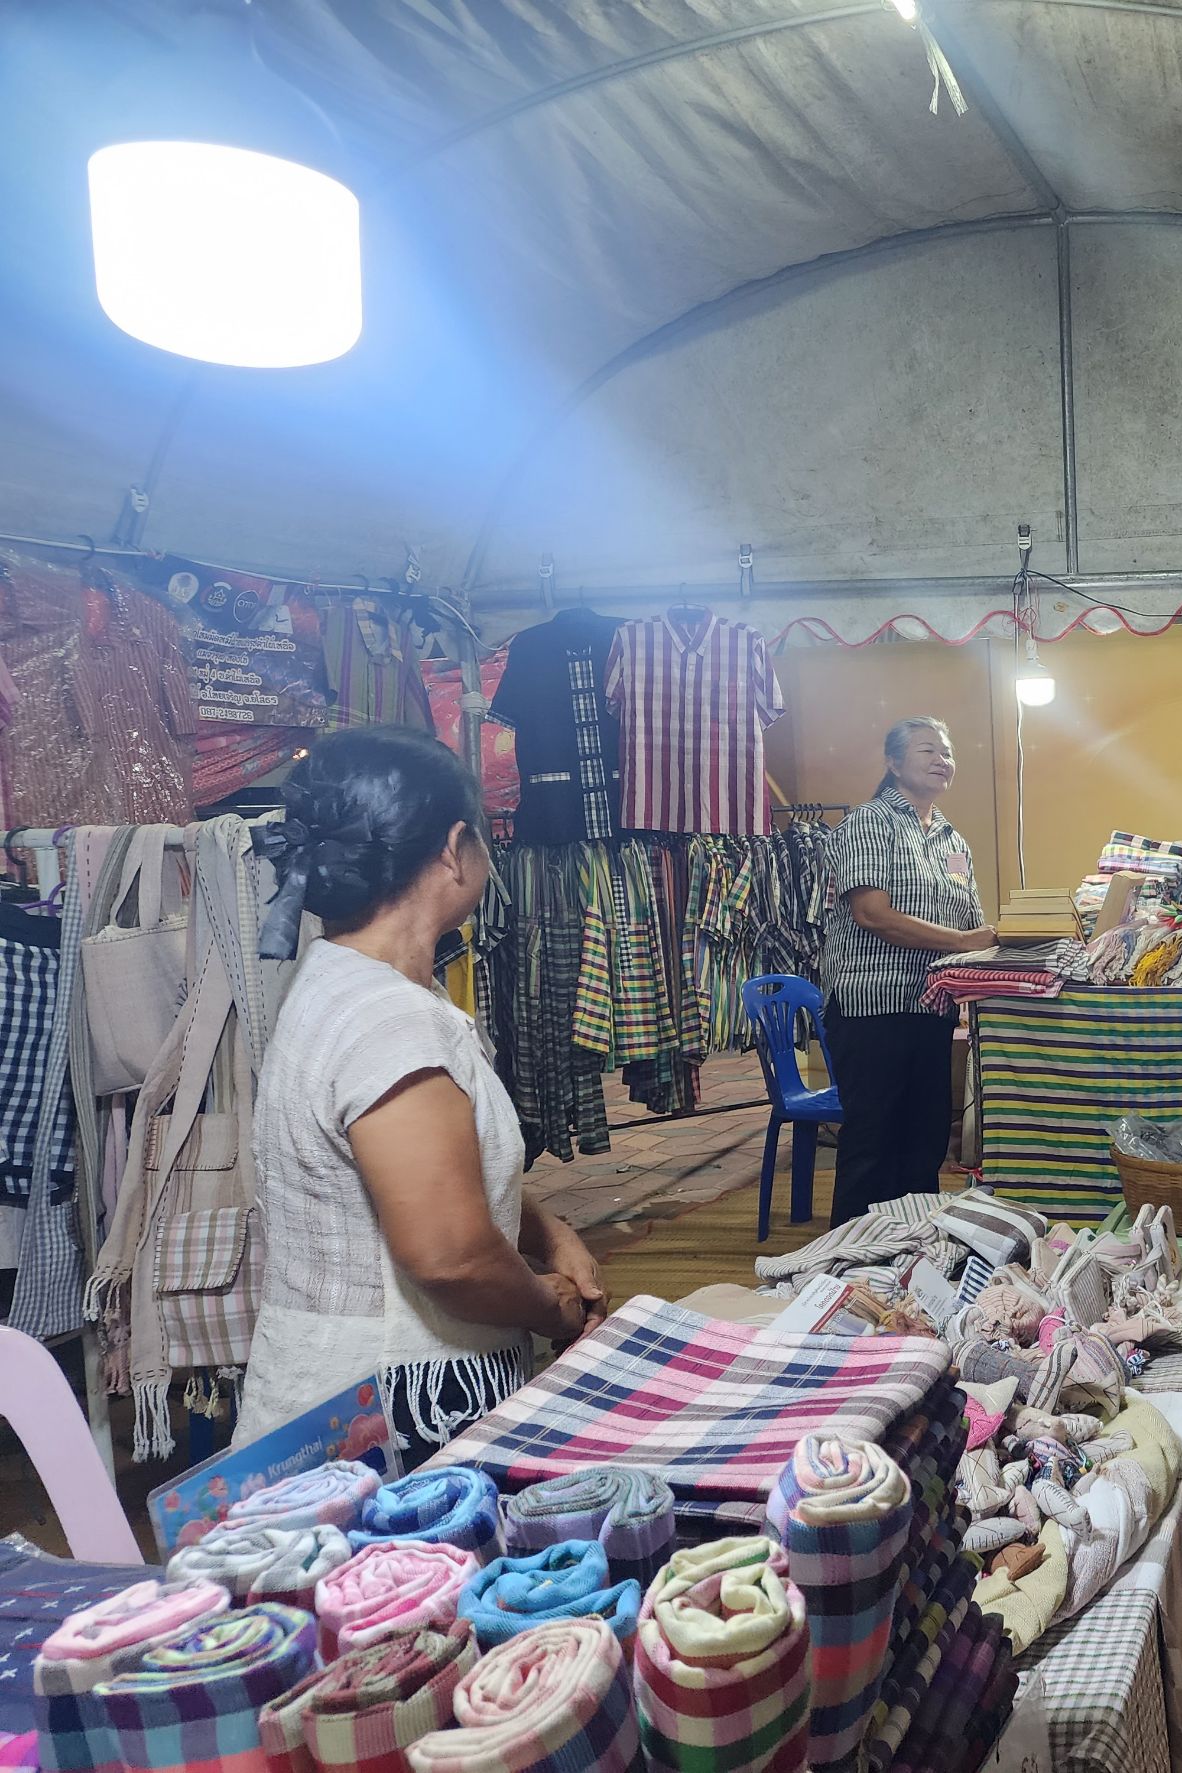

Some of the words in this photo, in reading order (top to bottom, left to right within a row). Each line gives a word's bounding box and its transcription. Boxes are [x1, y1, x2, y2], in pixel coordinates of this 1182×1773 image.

[210, 668, 217, 680] 4
[201, 685, 243, 705] อ.ไทยเจริญ
[244, 690, 279, 705] จ.ยโสธร
[267, 1435, 323, 1478] Krungthai
